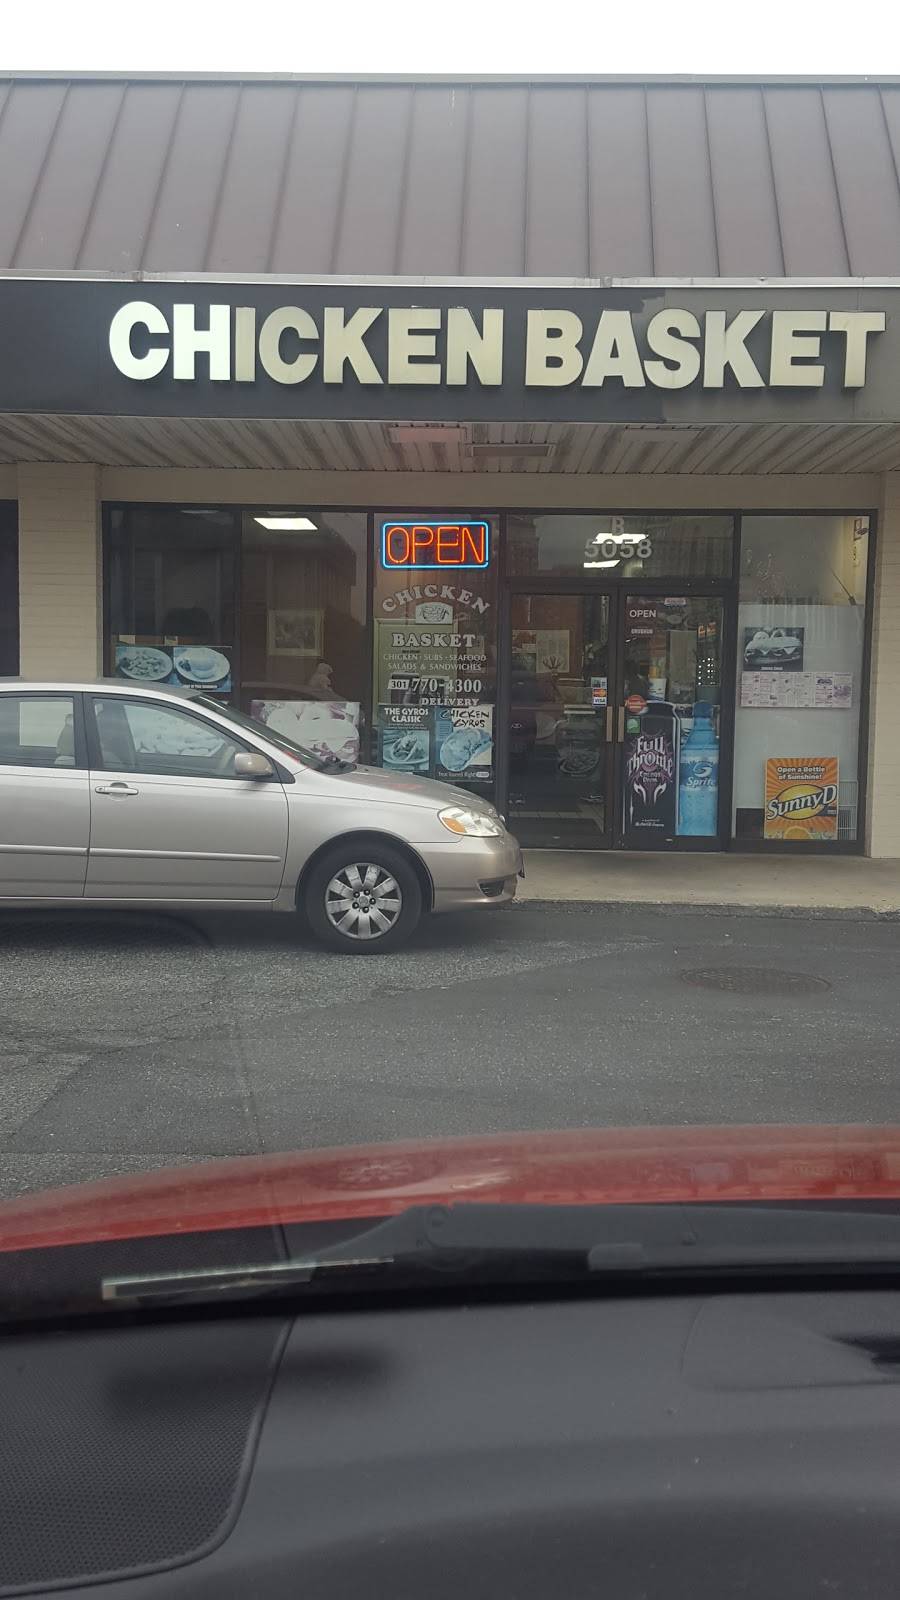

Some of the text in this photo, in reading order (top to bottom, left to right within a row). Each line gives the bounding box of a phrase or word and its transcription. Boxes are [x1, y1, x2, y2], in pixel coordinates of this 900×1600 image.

[108, 300, 886, 390] CHICKEN BASKET
[611, 516, 625, 535] B
[387, 526, 485, 564] OPEN
[584, 538, 652, 558] 5058
[382, 584, 491, 614] CHICKEN
[629, 609, 657, 618] OPEN
[392, 633, 476, 648] BASKET
[383, 653, 487, 662] CHICKEN SUBS SEAFOOD
[387, 662, 417, 670] SALADS
[430, 663, 482, 671] SANDWICHES
[391, 678, 482, 692] 301 770-4300
[421, 697, 480, 707] DELIVERY
[384, 707, 429, 716] THE GYROS
[440, 709, 490, 719] CHICKEN
[391, 715, 422, 723] CLASSIC
[777, 766, 796, 774] Open
